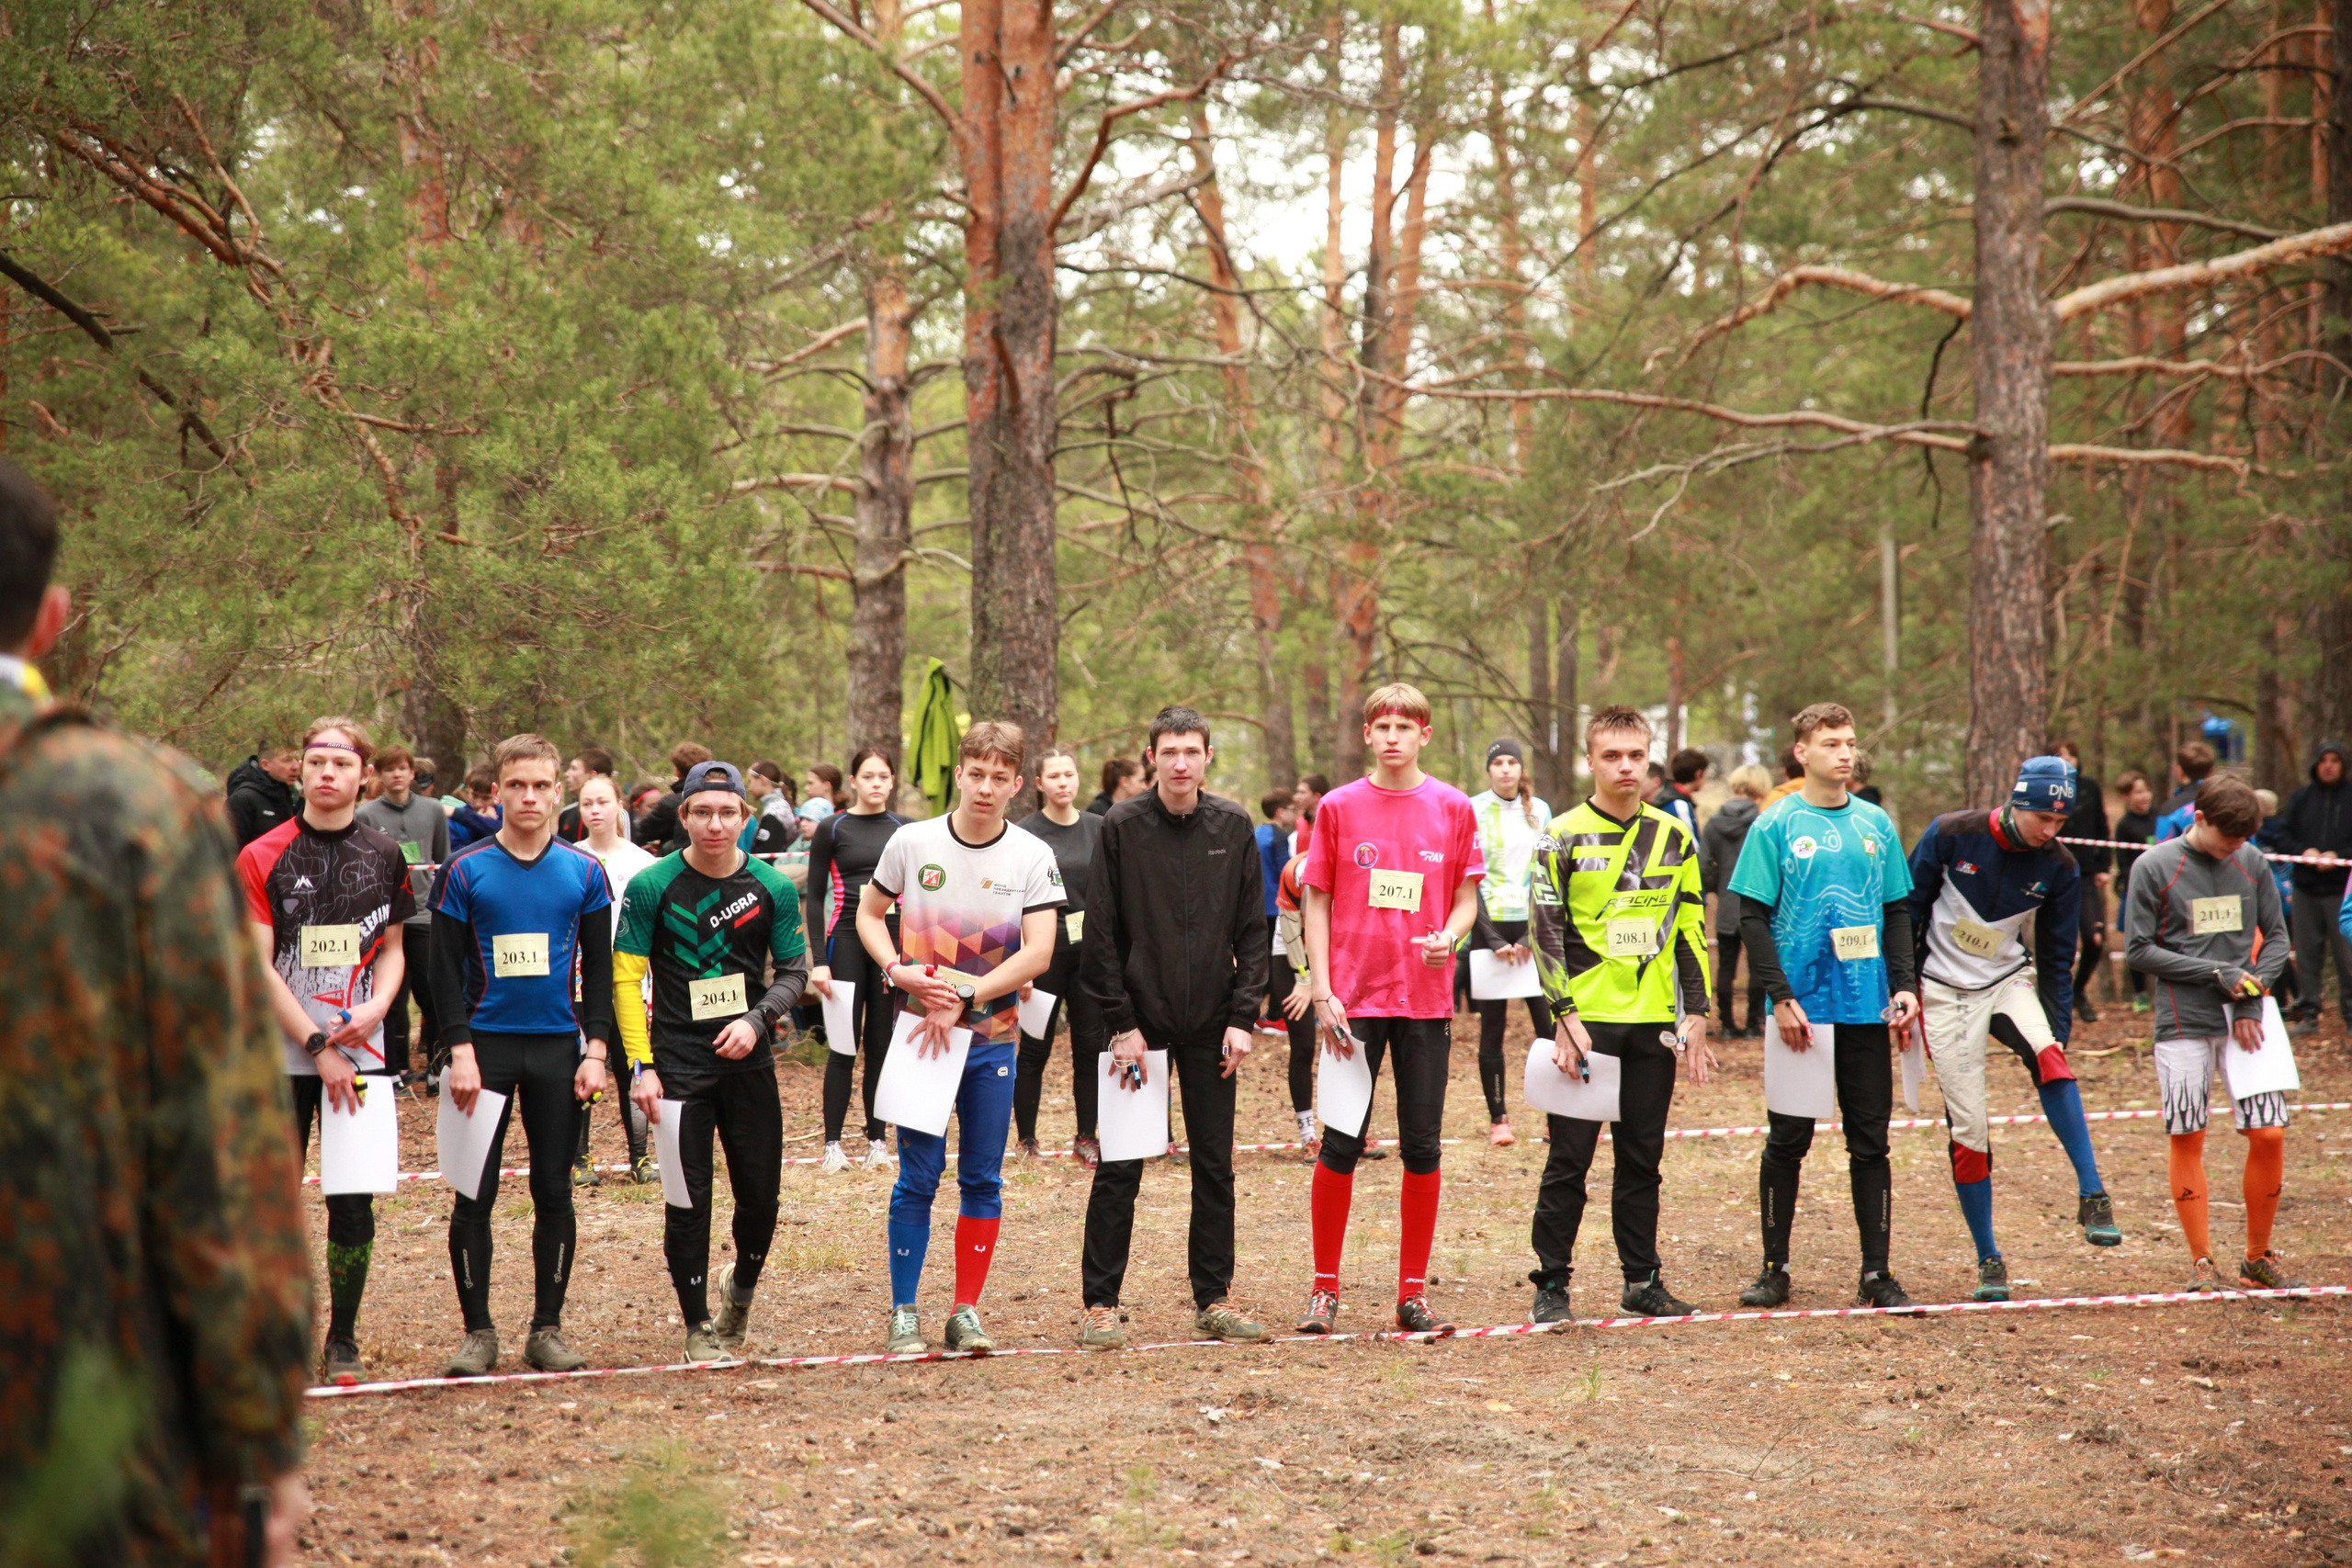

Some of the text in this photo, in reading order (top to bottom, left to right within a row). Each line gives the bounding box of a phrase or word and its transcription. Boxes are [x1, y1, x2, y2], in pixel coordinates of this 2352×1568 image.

[2048, 784, 2075, 800] DNB
[1379, 885, 1414, 899] 207.1
[2200, 908, 2230, 921] 211.1
[1615, 931, 1647, 944] 208.1
[1839, 935, 1867, 947] 209.1
[1958, 930, 1990, 950] 210.1
[310, 939, 348, 953] 202.1
[502, 951, 537, 965] 203.1
[701, 989, 738, 1007] 204.1
